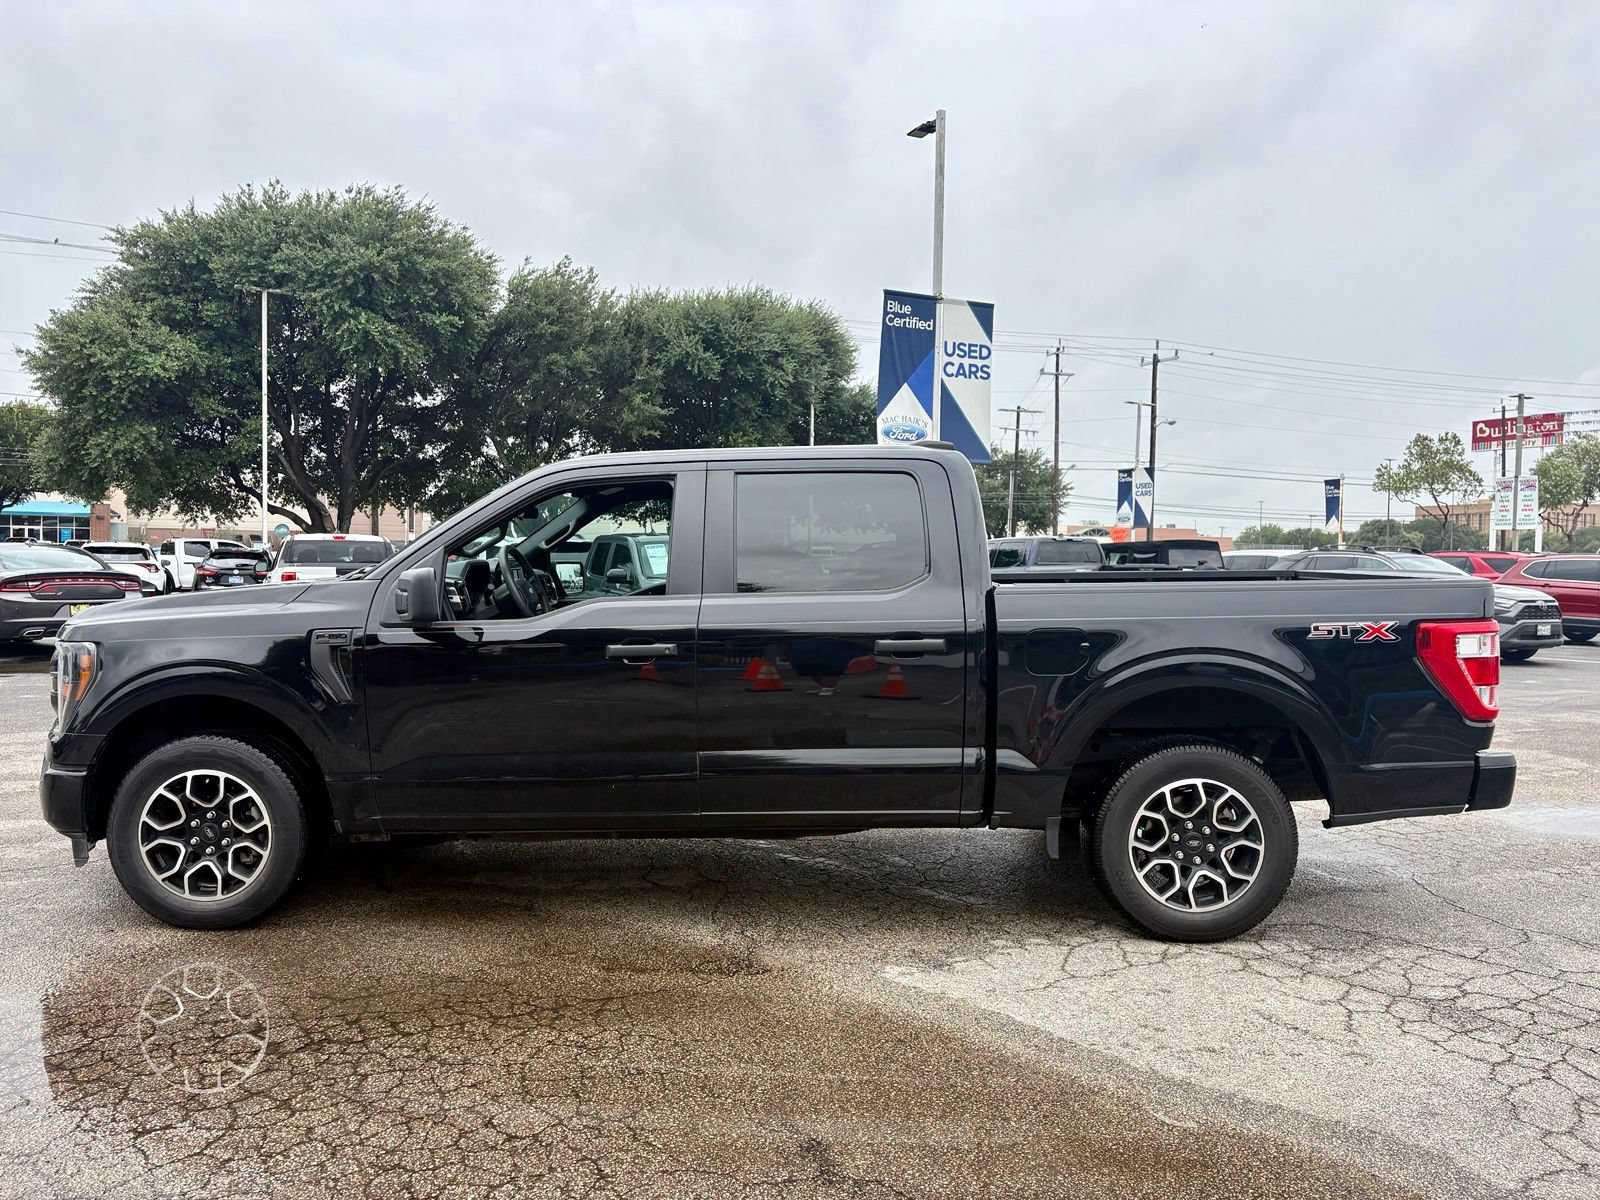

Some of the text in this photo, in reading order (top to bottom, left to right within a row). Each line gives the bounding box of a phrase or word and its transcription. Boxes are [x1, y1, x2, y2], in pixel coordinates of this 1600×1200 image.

[887, 300, 911, 314] Blue
[885, 314, 934, 331] Certified
[943, 340, 991, 360] USED
[943, 361, 991, 380] CARS
[881, 415, 929, 428] MAC HAIK'S
[1476, 421, 1559, 438] Bulington
[890, 426, 918, 440] Ford
[1135, 489, 1153, 497] CARS
[1306, 621, 1401, 643] STX
